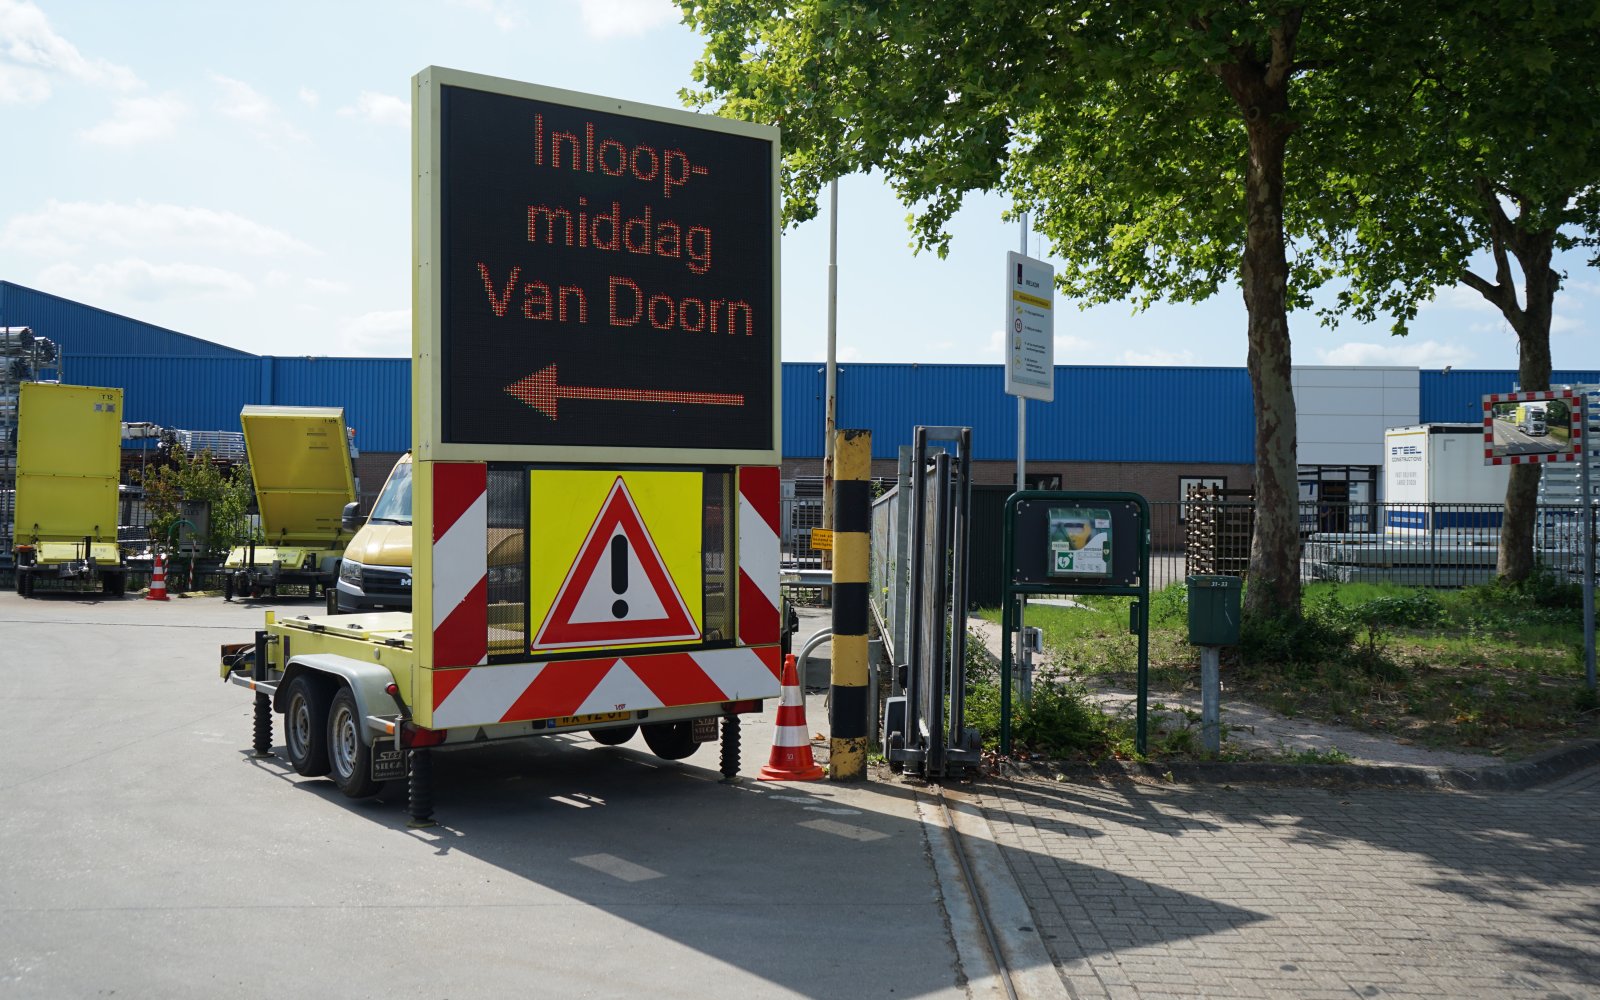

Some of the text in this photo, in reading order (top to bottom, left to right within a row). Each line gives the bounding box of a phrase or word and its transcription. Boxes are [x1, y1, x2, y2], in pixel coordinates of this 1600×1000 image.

[534, 112, 709, 198] Inloop-
[527, 196, 711, 275] middag
[477, 261, 753, 336] Van Doorn
[1392, 446, 1422, 455] STEEL
